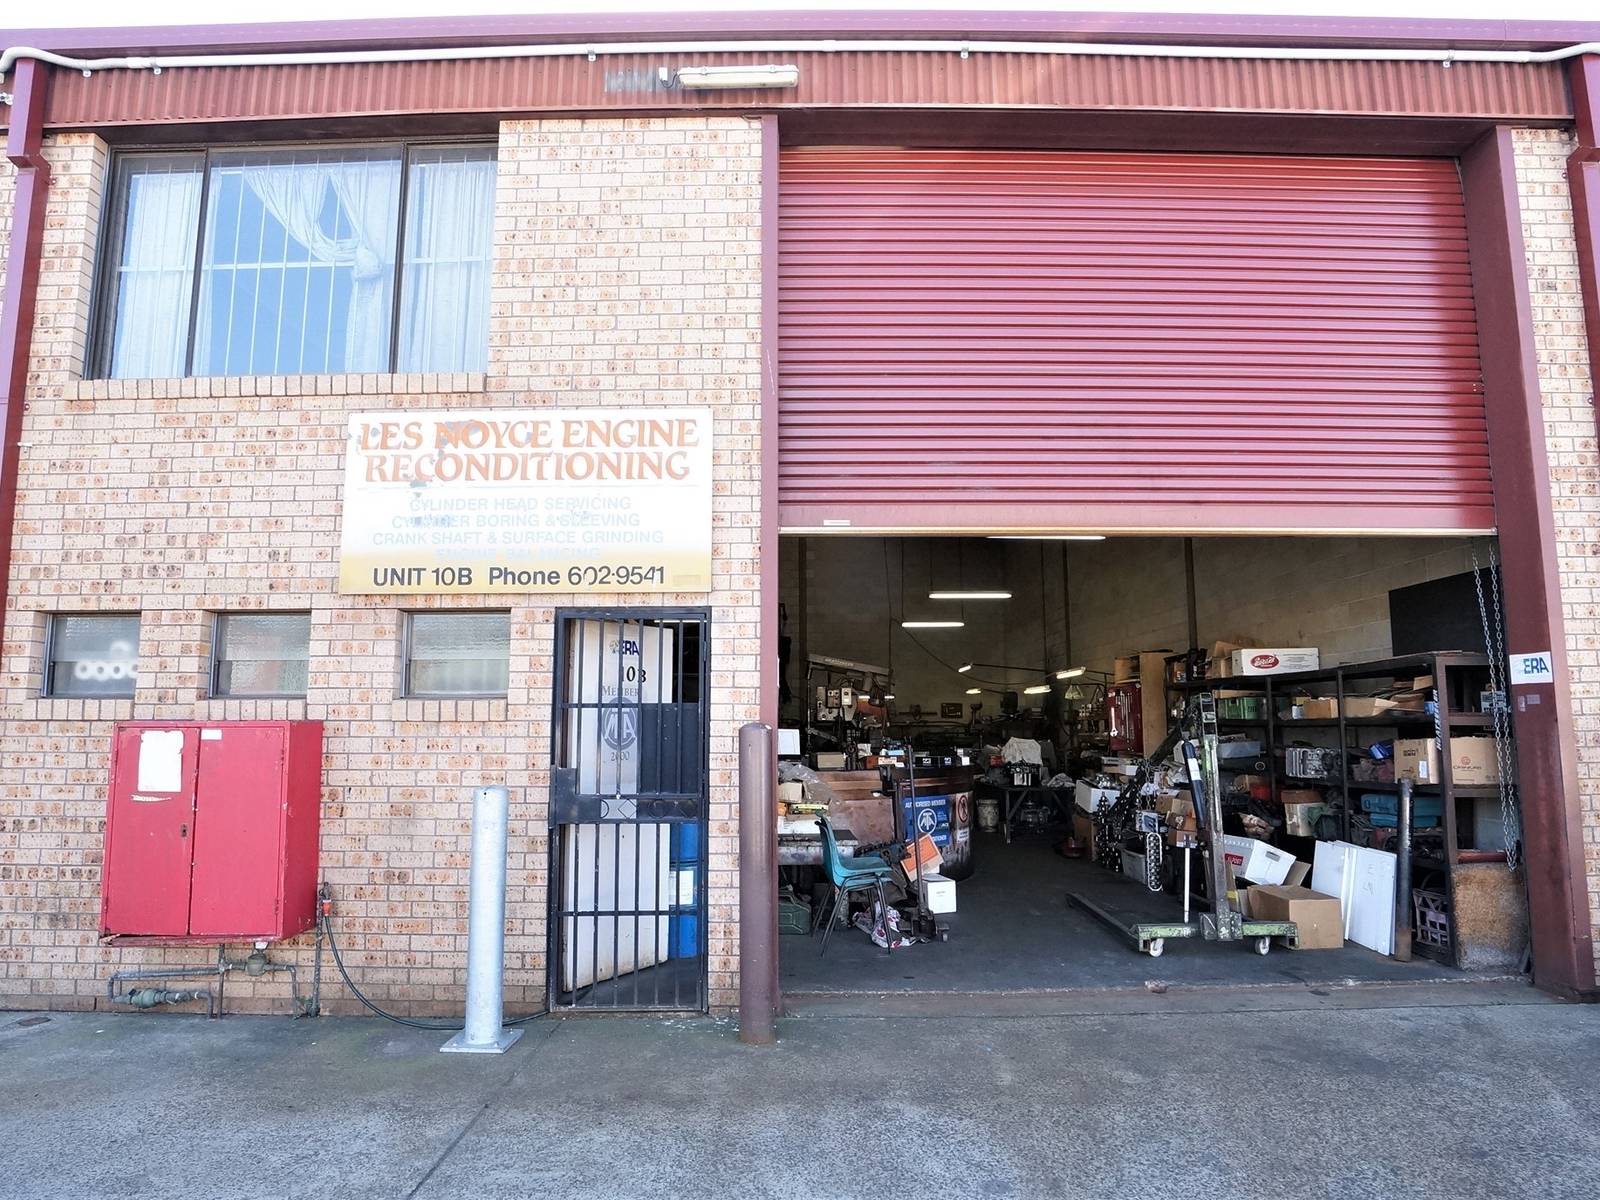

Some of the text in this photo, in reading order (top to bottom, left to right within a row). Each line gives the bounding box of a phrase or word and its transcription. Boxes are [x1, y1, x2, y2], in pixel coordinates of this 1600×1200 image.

[360, 419, 699, 450] LES NOYCE ENGINE
[365, 451, 691, 482] RECONDITIONING
[409, 496, 632, 512] CYLINDER HEAD SERVICING
[476, 513, 542, 528] BORING
[372, 530, 664, 546] CRANK SHAFT & SURFACE GRINDING
[373, 567, 426, 587] UNIT
[432, 567, 473, 586] 10B
[489, 566, 561, 586] Phone
[622, 665, 647, 683] 0B
[1523, 656, 1549, 674] ERA
[602, 684, 640, 697] MEBER
